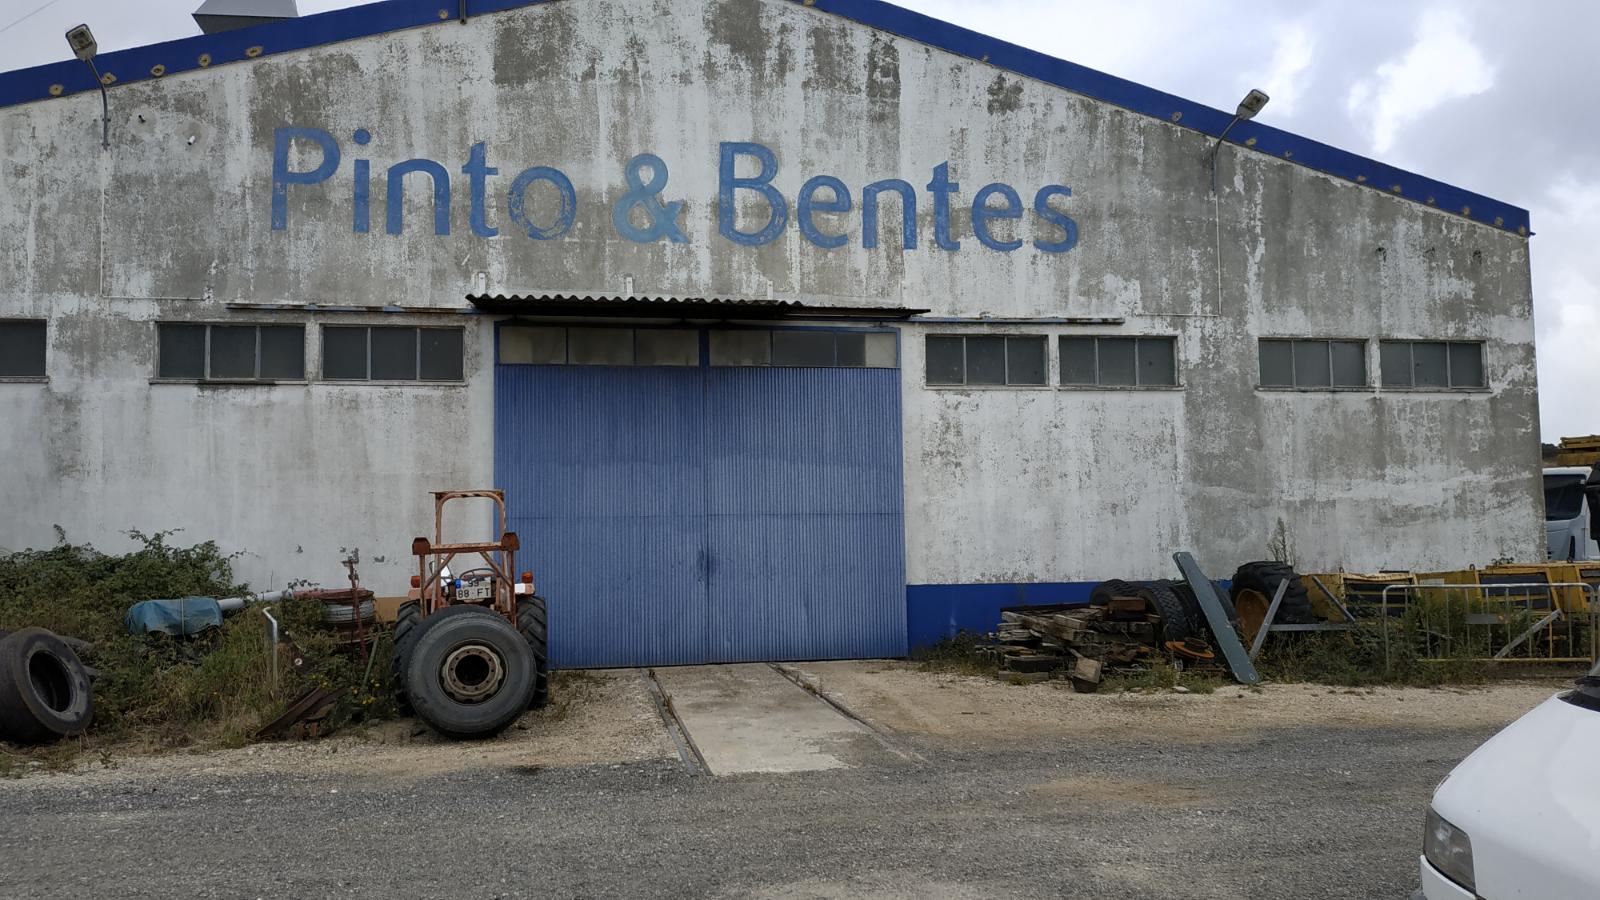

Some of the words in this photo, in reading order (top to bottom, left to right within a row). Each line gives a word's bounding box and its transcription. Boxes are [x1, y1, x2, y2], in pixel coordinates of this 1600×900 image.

[271, 127, 577, 241] Pinto
[612, 153, 692, 244] &
[718, 141, 1079, 253] Bentes
